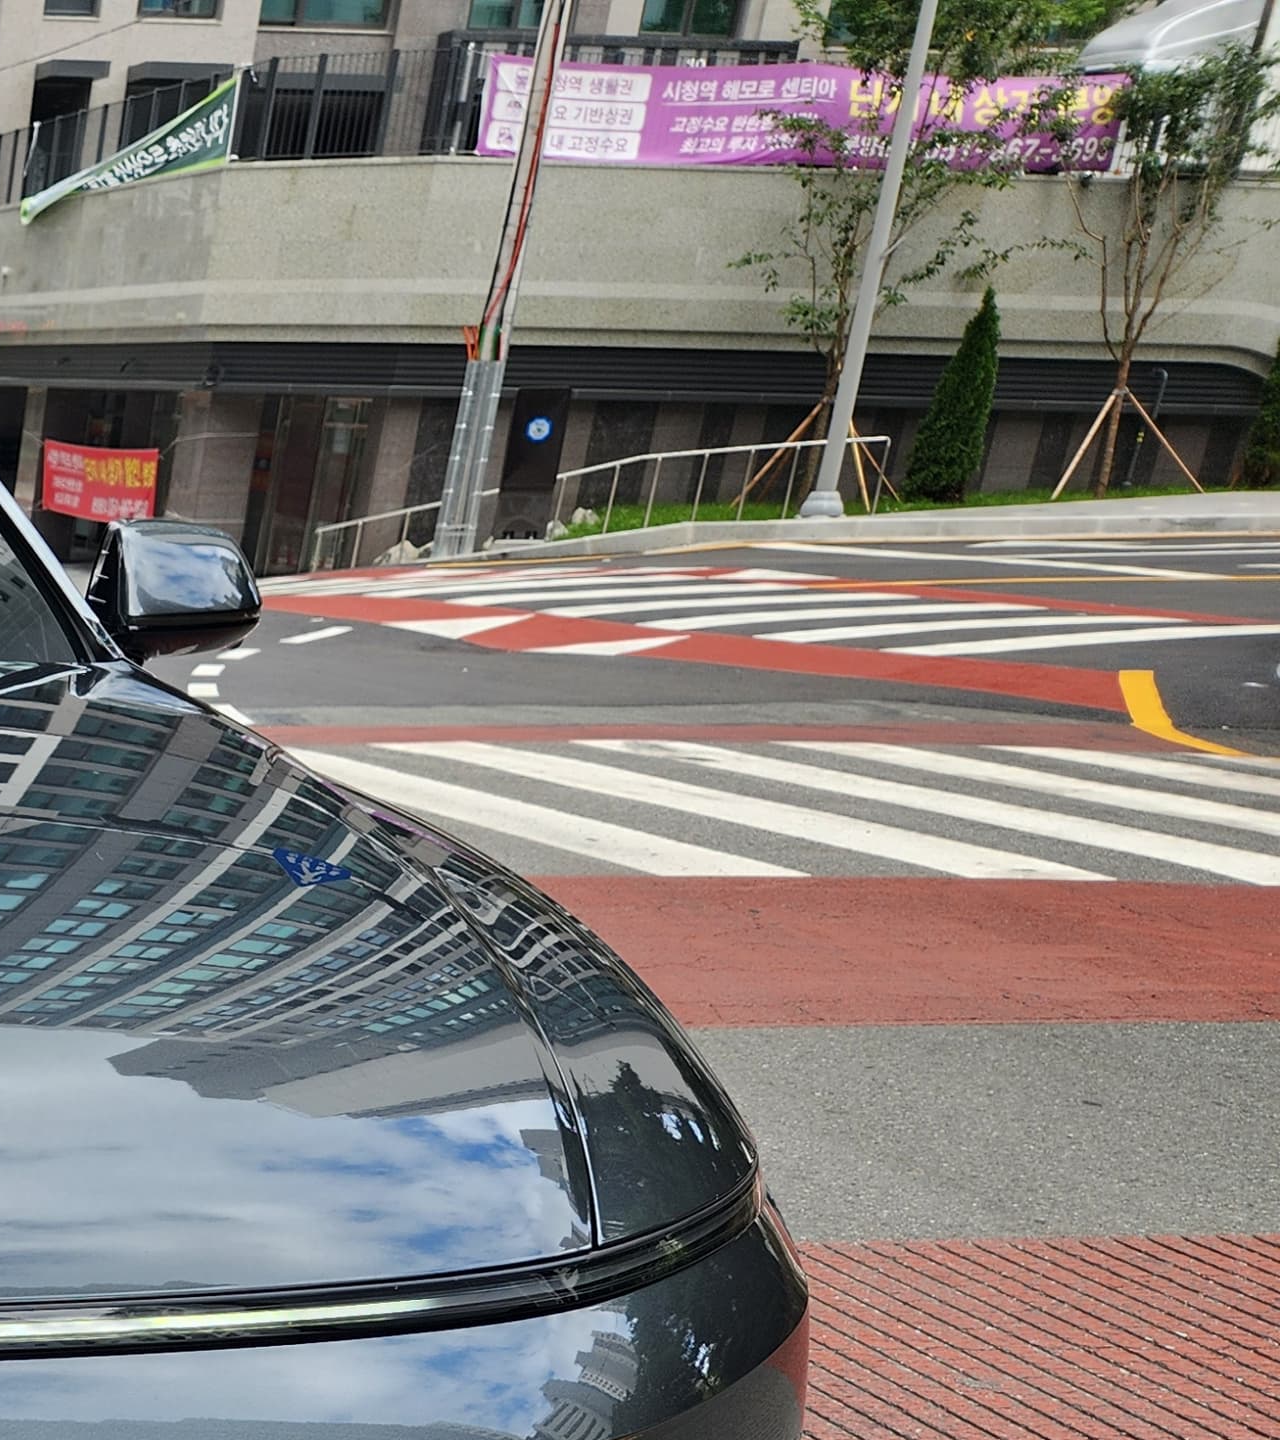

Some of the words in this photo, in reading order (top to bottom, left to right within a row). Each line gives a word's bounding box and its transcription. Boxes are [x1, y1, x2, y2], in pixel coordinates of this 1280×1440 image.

[662, 79, 718, 102] 시청역
[721, 79, 776, 100] 해모로
[781, 76, 837, 99] 센티아
[574, 106, 633, 126] 기반상권
[669, 116, 729, 133] 고정수요
[570, 137, 628, 154] 고정수요
